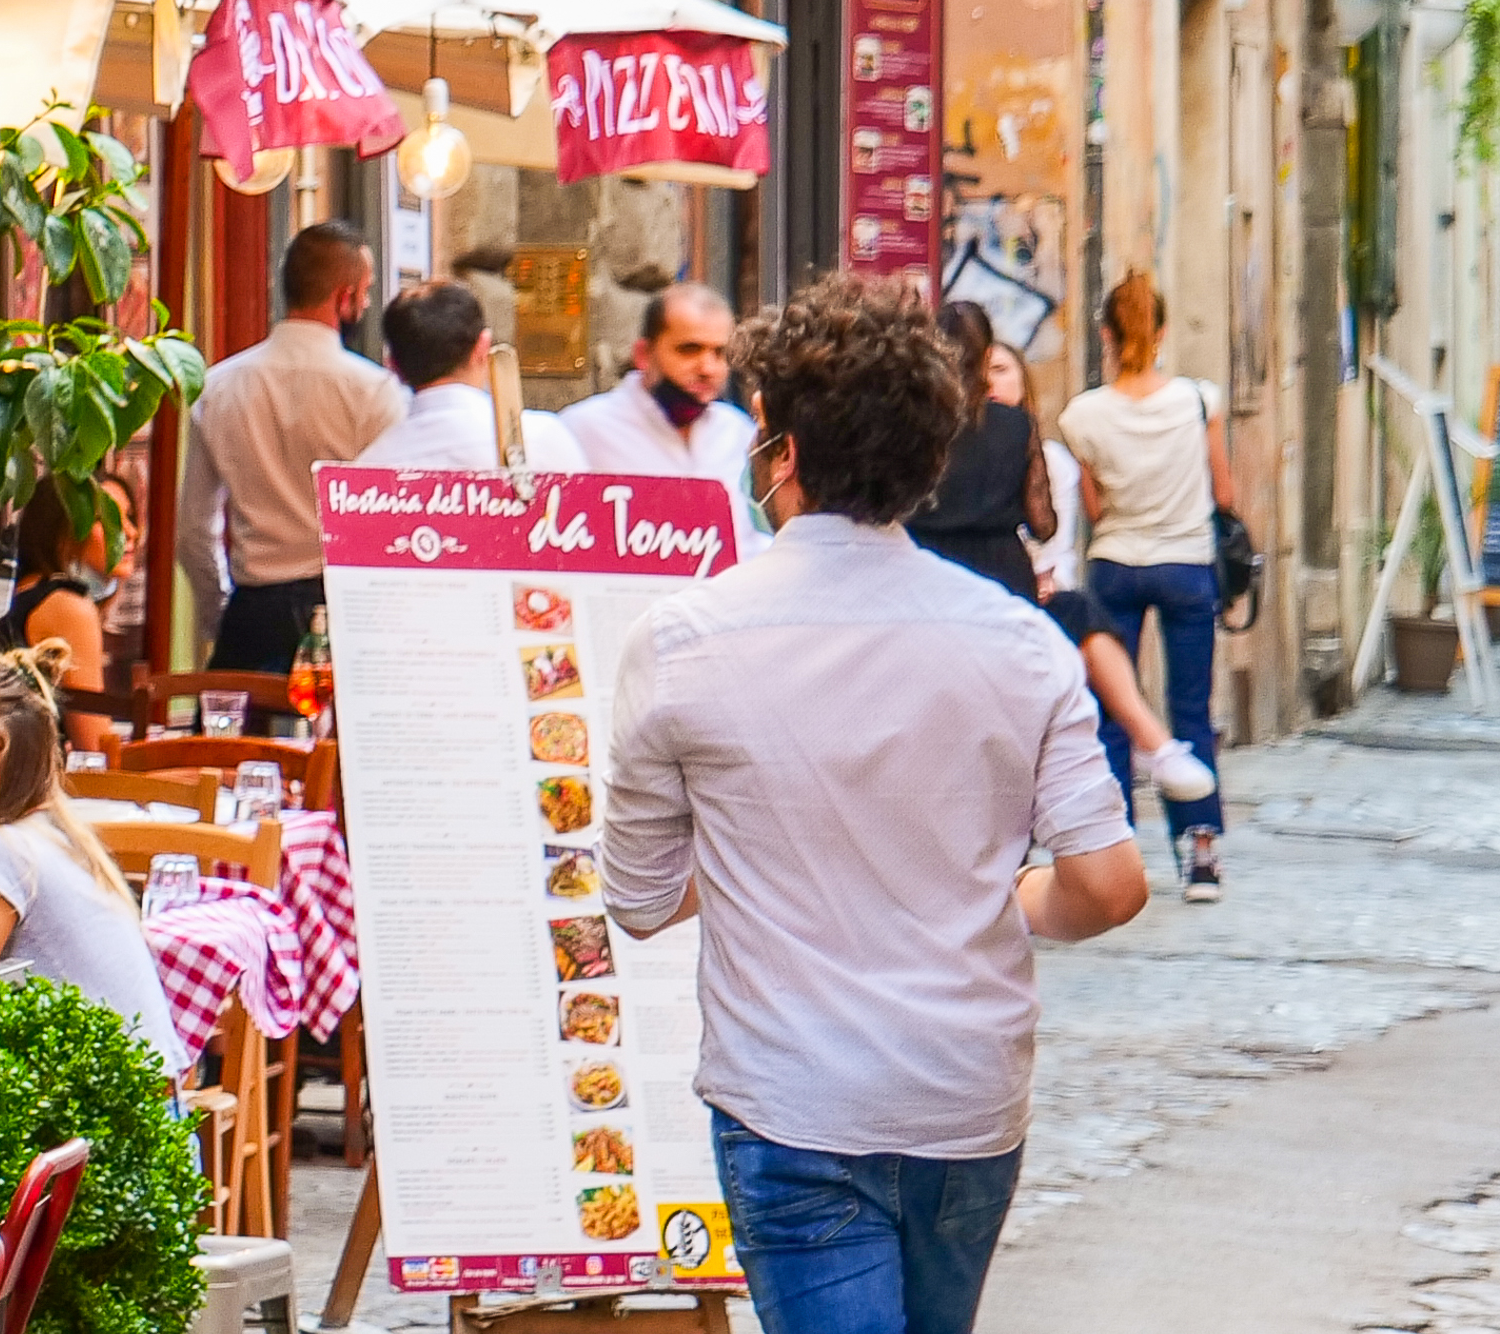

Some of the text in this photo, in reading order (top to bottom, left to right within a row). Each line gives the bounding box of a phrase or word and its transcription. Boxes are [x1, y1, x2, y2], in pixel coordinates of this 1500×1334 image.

[425, 482, 466, 515] del
[528, 485, 723, 578] da Tony
